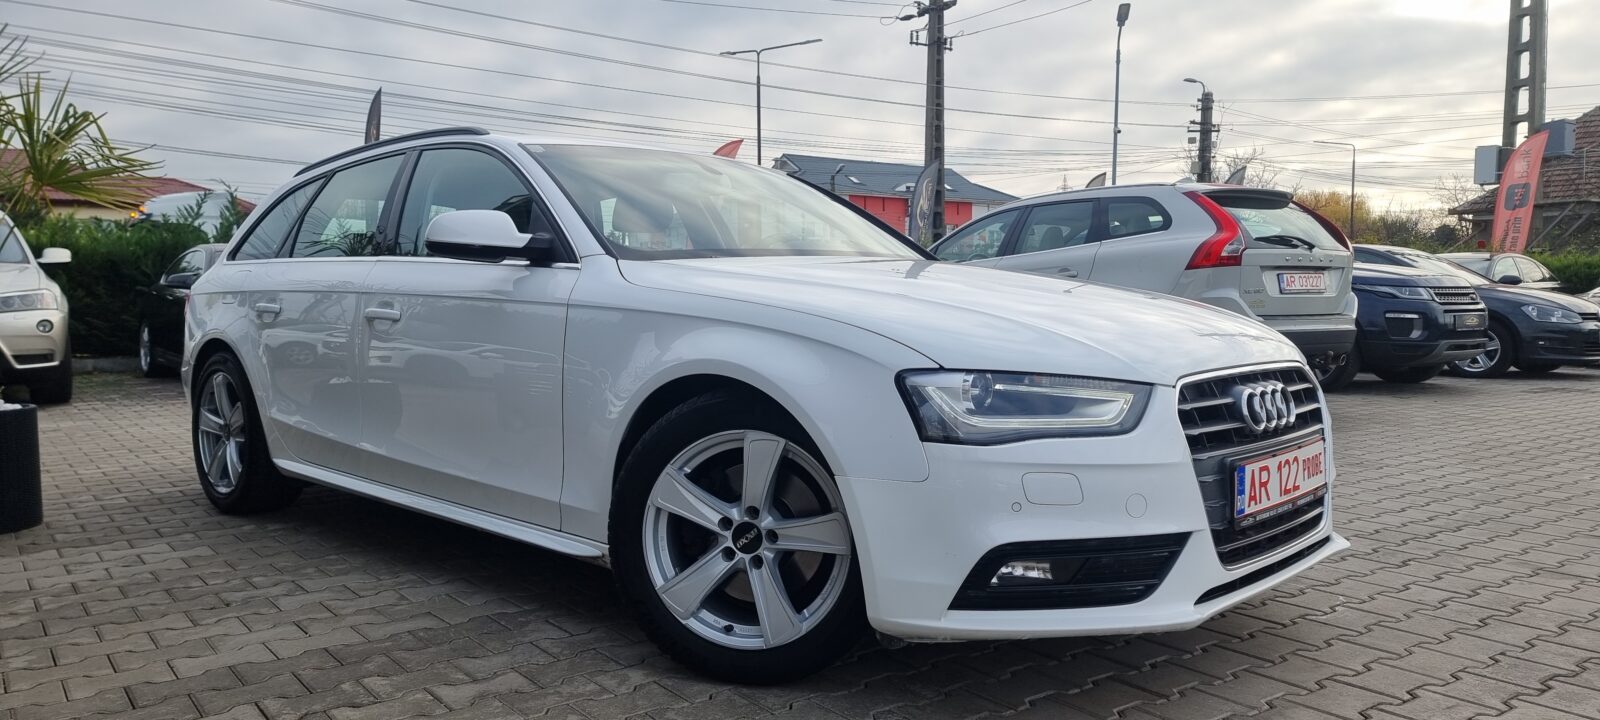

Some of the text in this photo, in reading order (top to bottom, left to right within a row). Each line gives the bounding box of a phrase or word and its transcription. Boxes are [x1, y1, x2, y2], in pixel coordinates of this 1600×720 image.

[1518, 149, 1532, 178] bank
[1286, 275, 1322, 288] AR 031227
[1248, 465, 1271, 508] AR
[1277, 456, 1300, 497] 122
[1302, 452, 1323, 482] PROBE
[1237, 494, 1245, 511] RO
